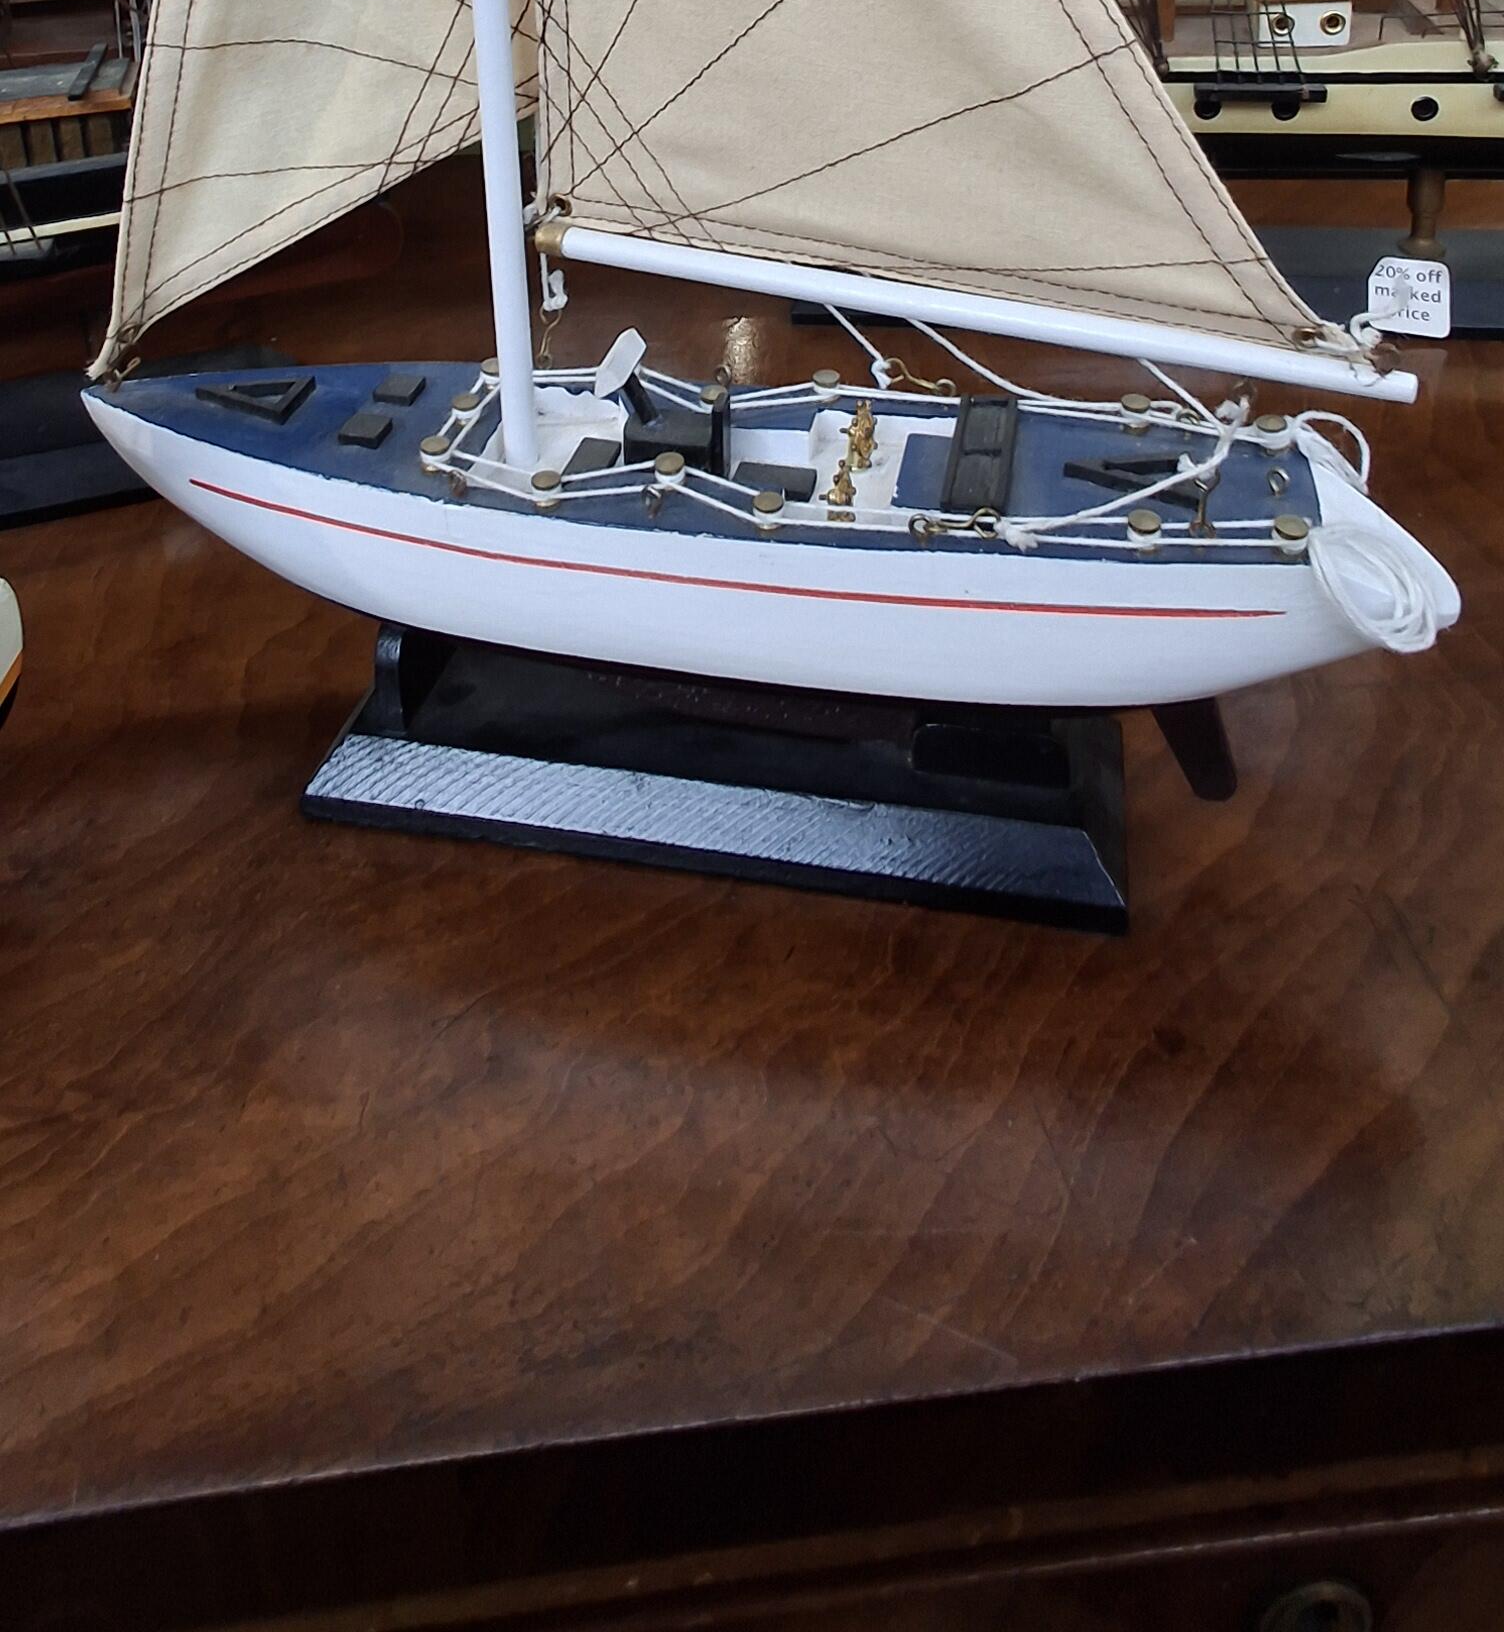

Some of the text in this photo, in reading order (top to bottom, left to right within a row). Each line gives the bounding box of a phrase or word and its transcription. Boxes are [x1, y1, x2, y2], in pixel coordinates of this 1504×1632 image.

[1375, 264, 1442, 284] 20% off
[1375, 285, 1441, 303] maked
[1391, 306, 1430, 321] rice
